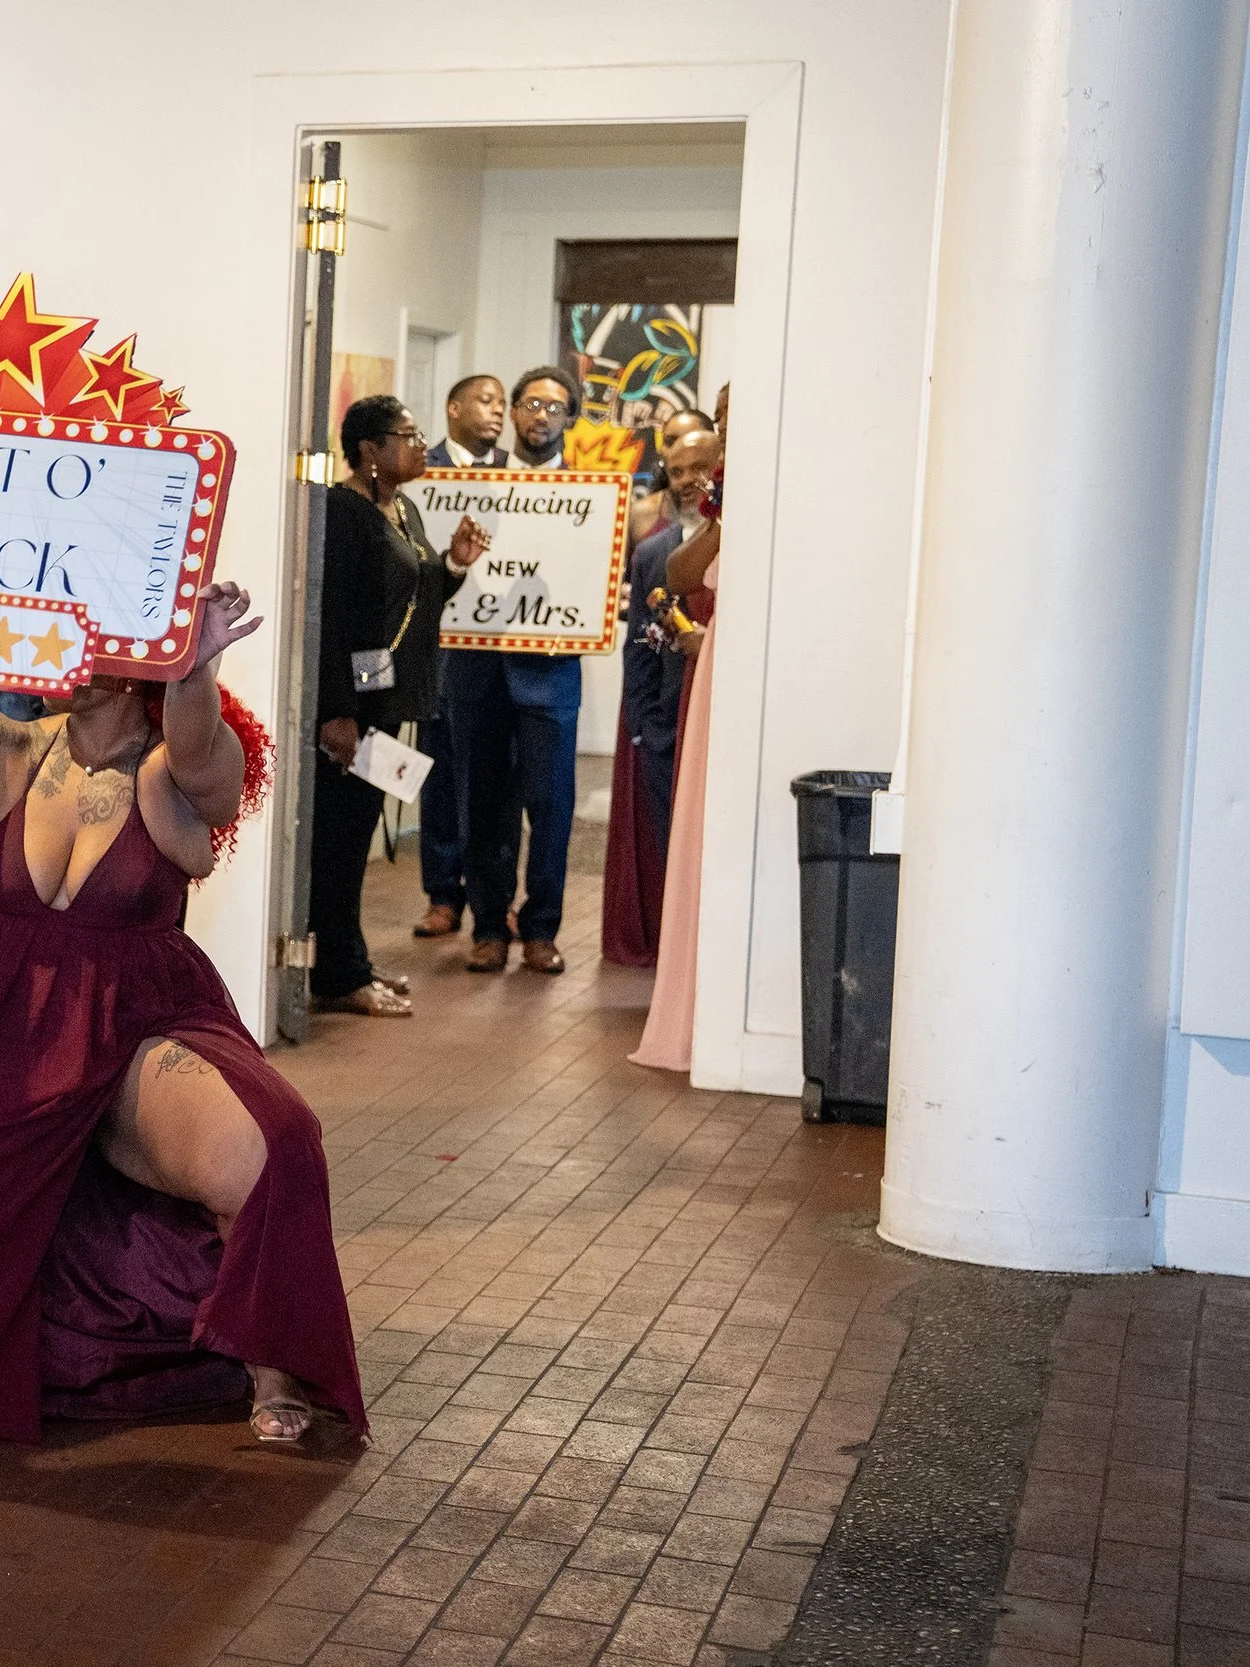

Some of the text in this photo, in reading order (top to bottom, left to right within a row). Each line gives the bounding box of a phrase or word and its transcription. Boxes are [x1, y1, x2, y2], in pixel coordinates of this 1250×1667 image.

[423, 486, 592, 527] Introducing
[141, 471, 188, 619] THE TAYLORS
[487, 560, 539, 577] NEW
[472, 593, 499, 623] &
[505, 595, 585, 627] Mrs.
